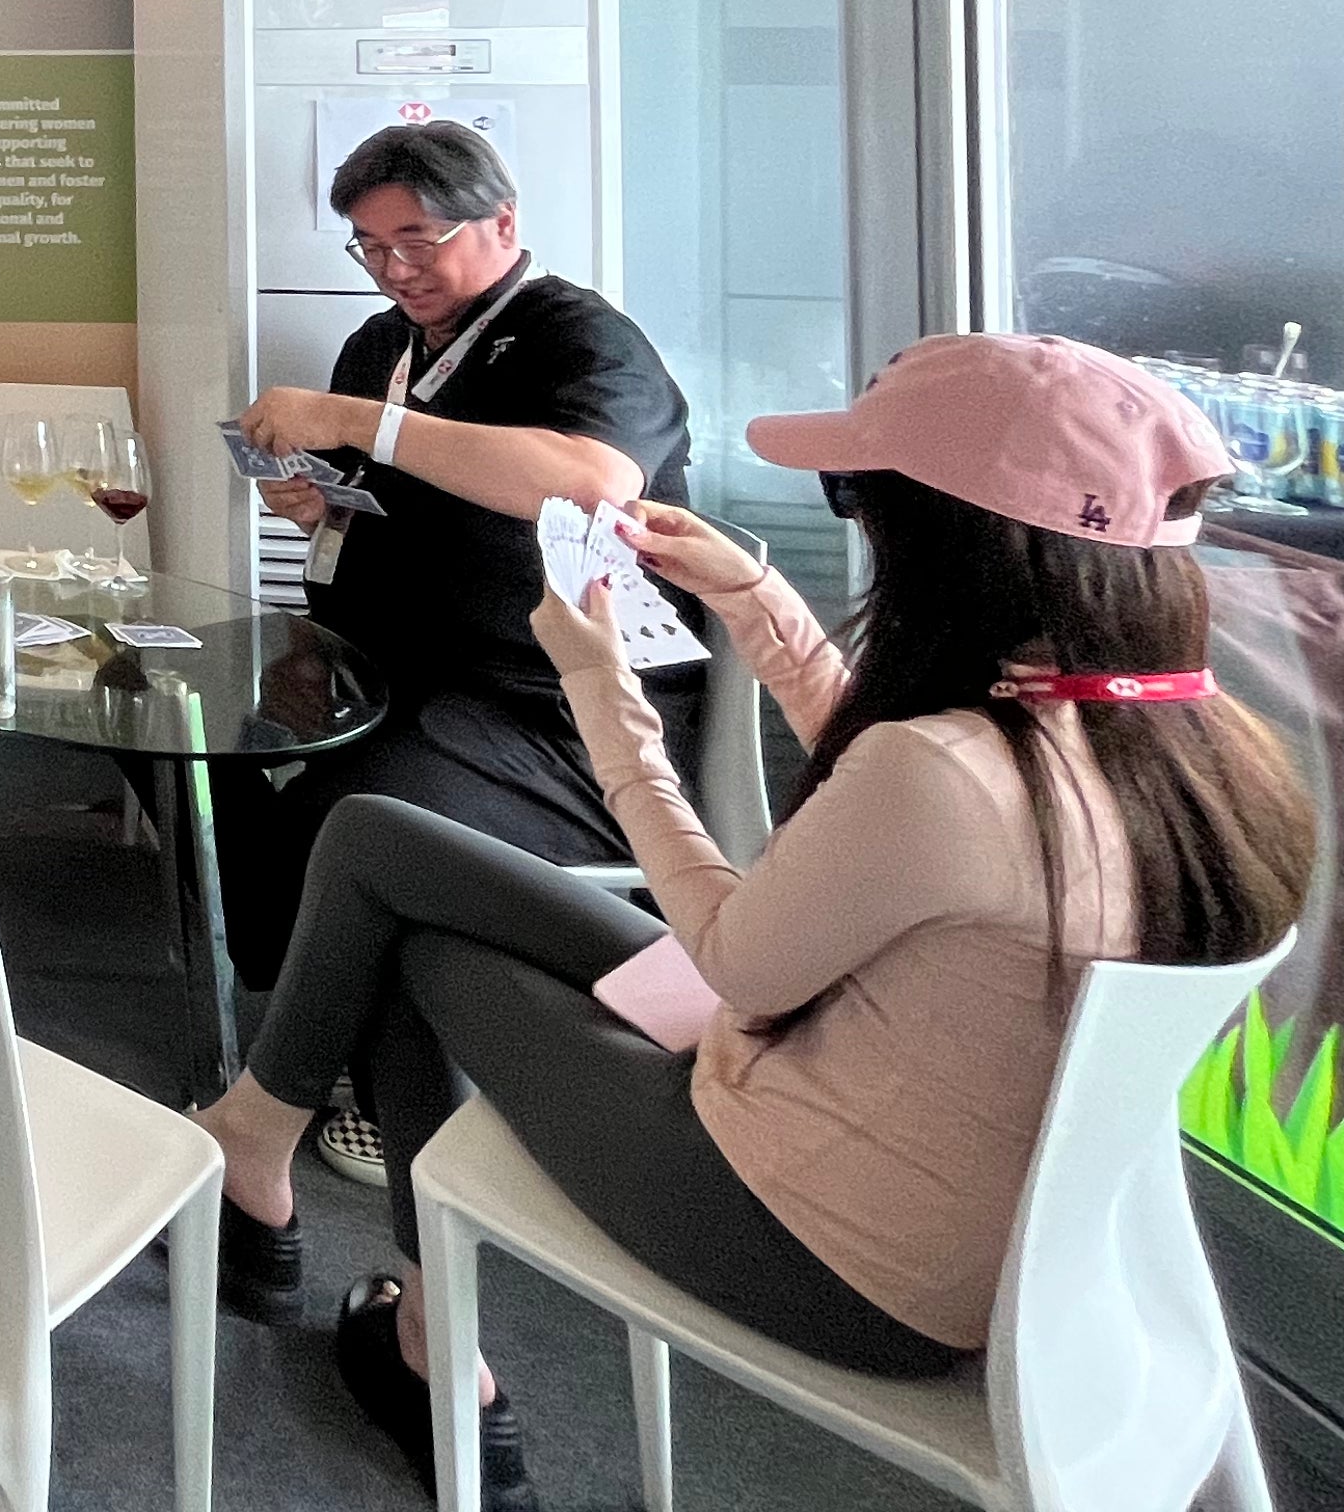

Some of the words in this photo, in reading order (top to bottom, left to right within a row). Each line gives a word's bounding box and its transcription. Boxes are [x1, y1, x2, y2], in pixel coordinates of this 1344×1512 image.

[42, 119, 95, 129] women
[79, 156, 94, 167] to
[29, 175, 56, 187] and
[60, 174, 105, 187] foster
[51, 193, 73, 205] for
[36, 213, 63, 224] and
[1077, 493, 1112, 532] LA
